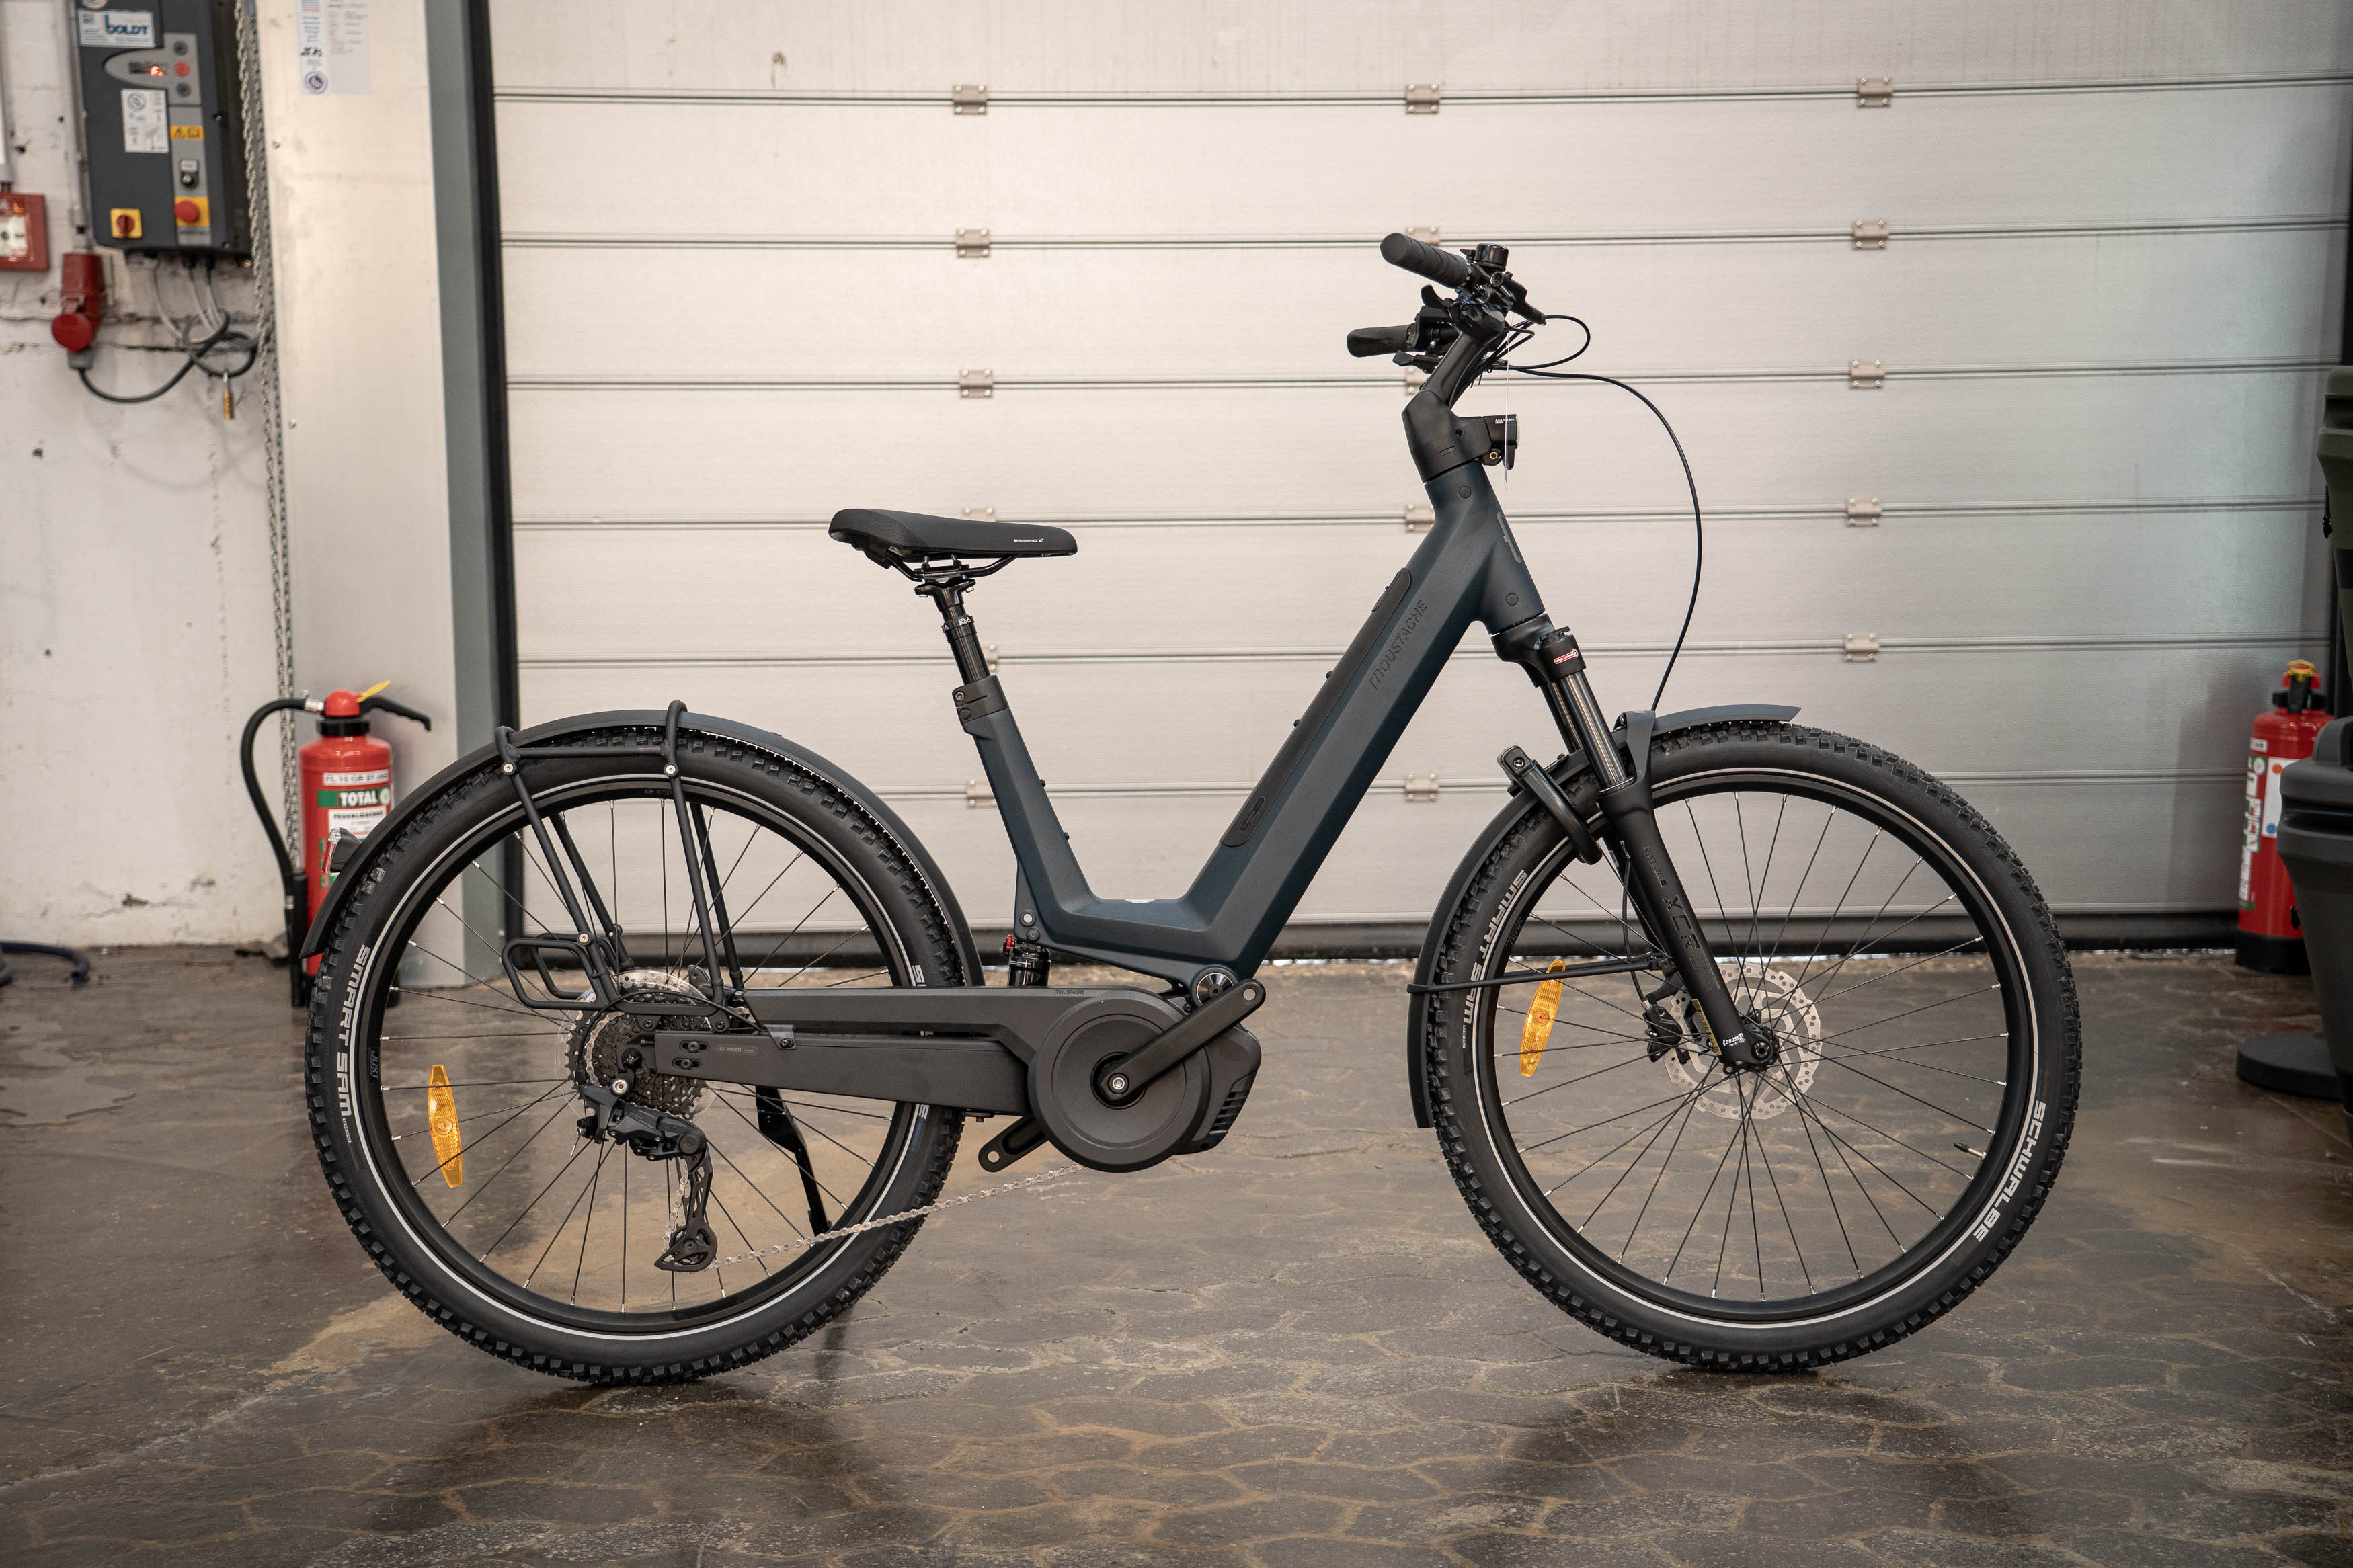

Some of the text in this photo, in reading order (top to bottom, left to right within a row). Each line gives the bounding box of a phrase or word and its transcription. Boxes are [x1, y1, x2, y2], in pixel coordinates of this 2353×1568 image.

[1368, 598, 1428, 690] MOUSTACHE
[340, 790, 378, 807] TOTAL
[1478, 869, 1528, 960] SMART
[337, 944, 371, 1116] SMART SAM
[1972, 1100, 2046, 1242] SCHWALBE
